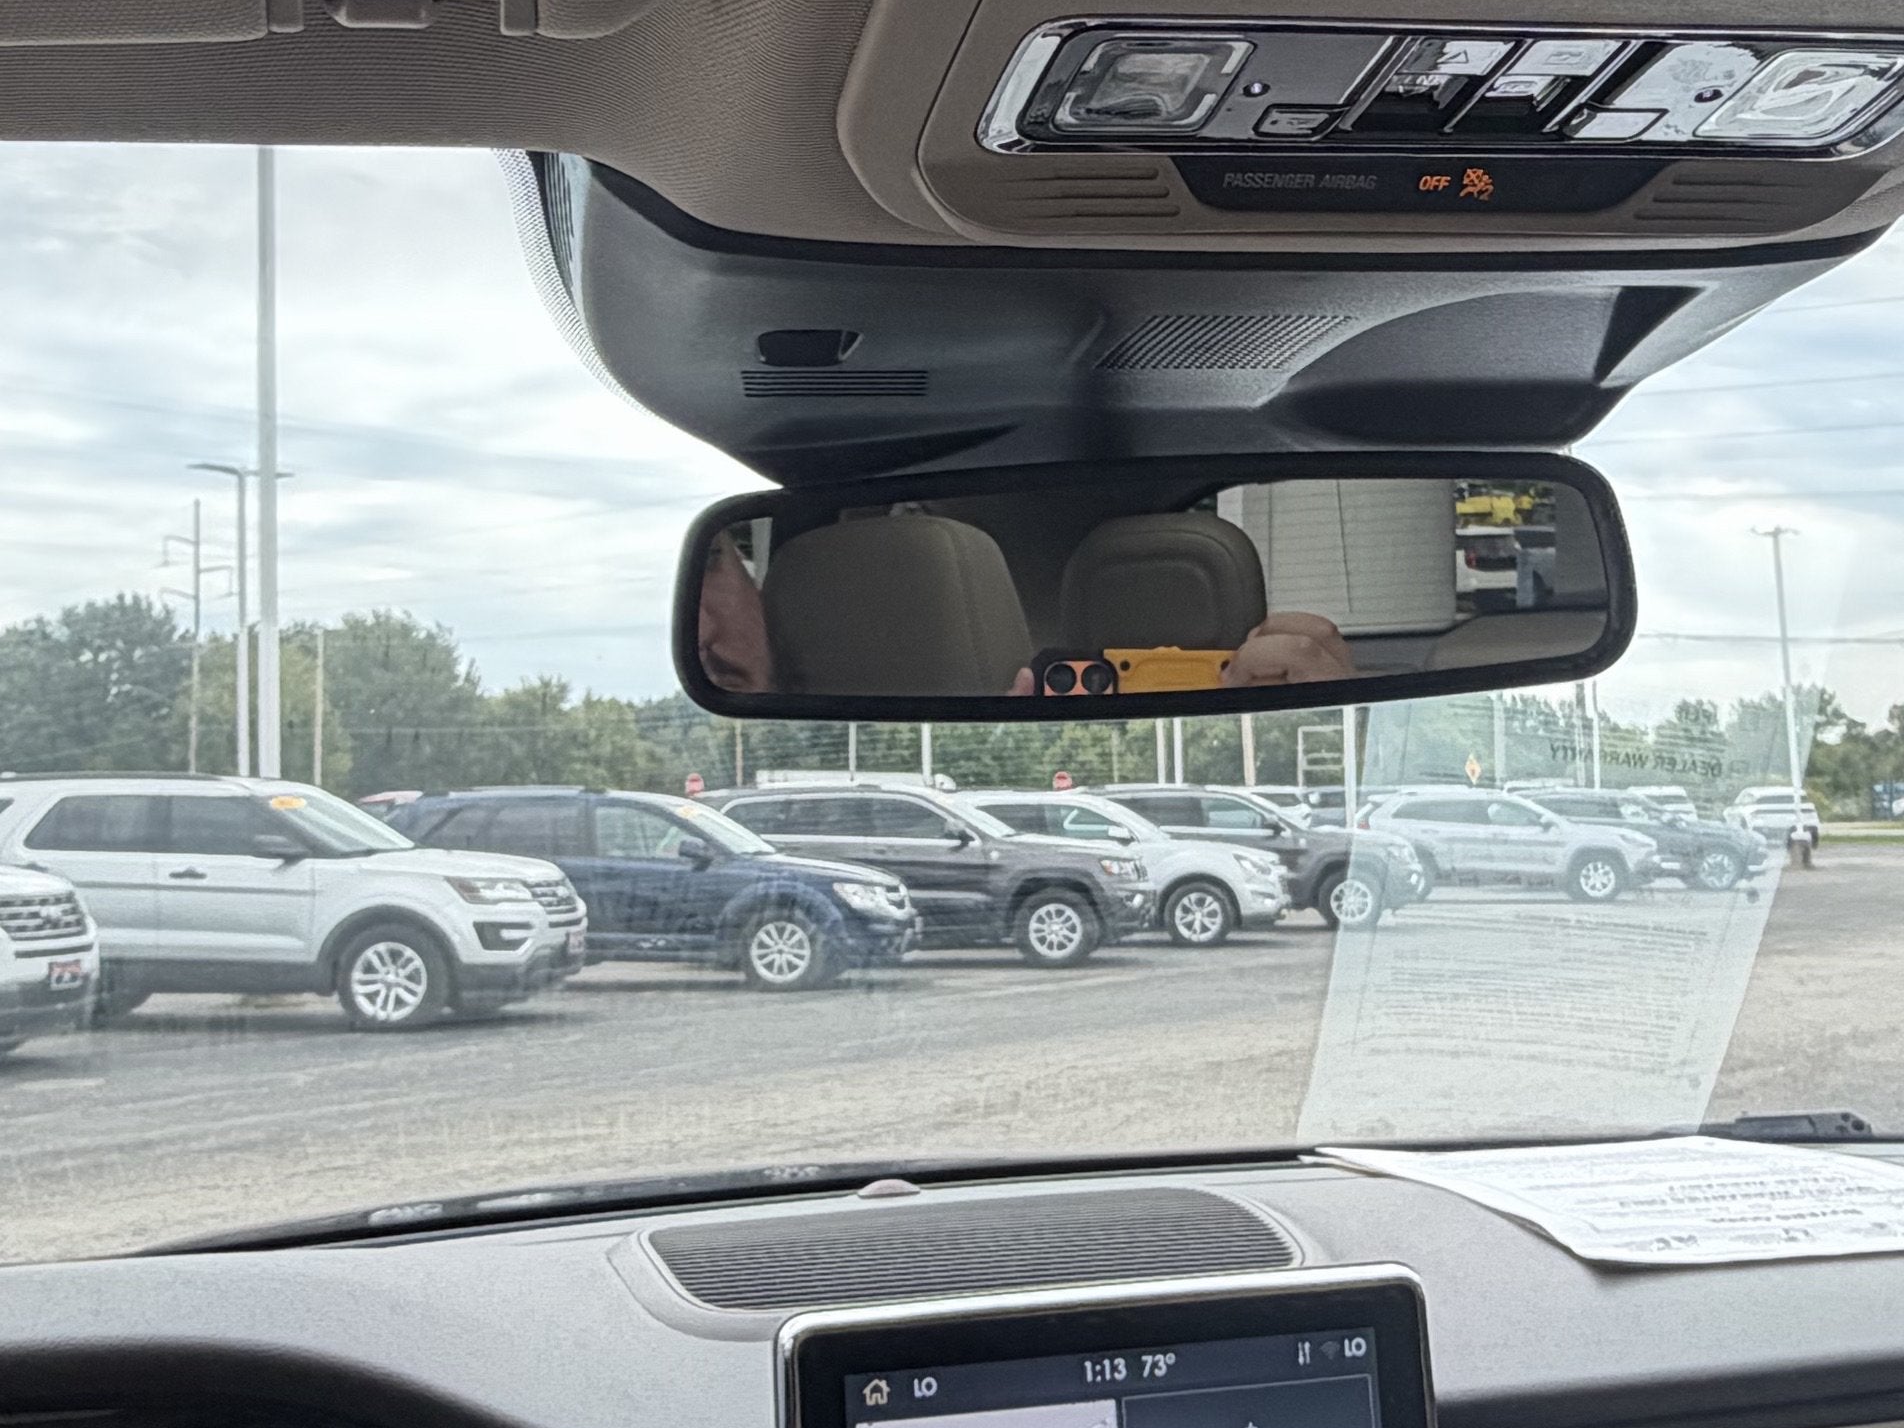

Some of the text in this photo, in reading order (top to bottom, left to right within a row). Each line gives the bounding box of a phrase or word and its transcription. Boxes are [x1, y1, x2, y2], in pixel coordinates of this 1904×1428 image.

[1222, 172, 1452, 191] PASSENGER AIRBAG OFF
[912, 1336, 1368, 1398] LO 1:13 73° LO
